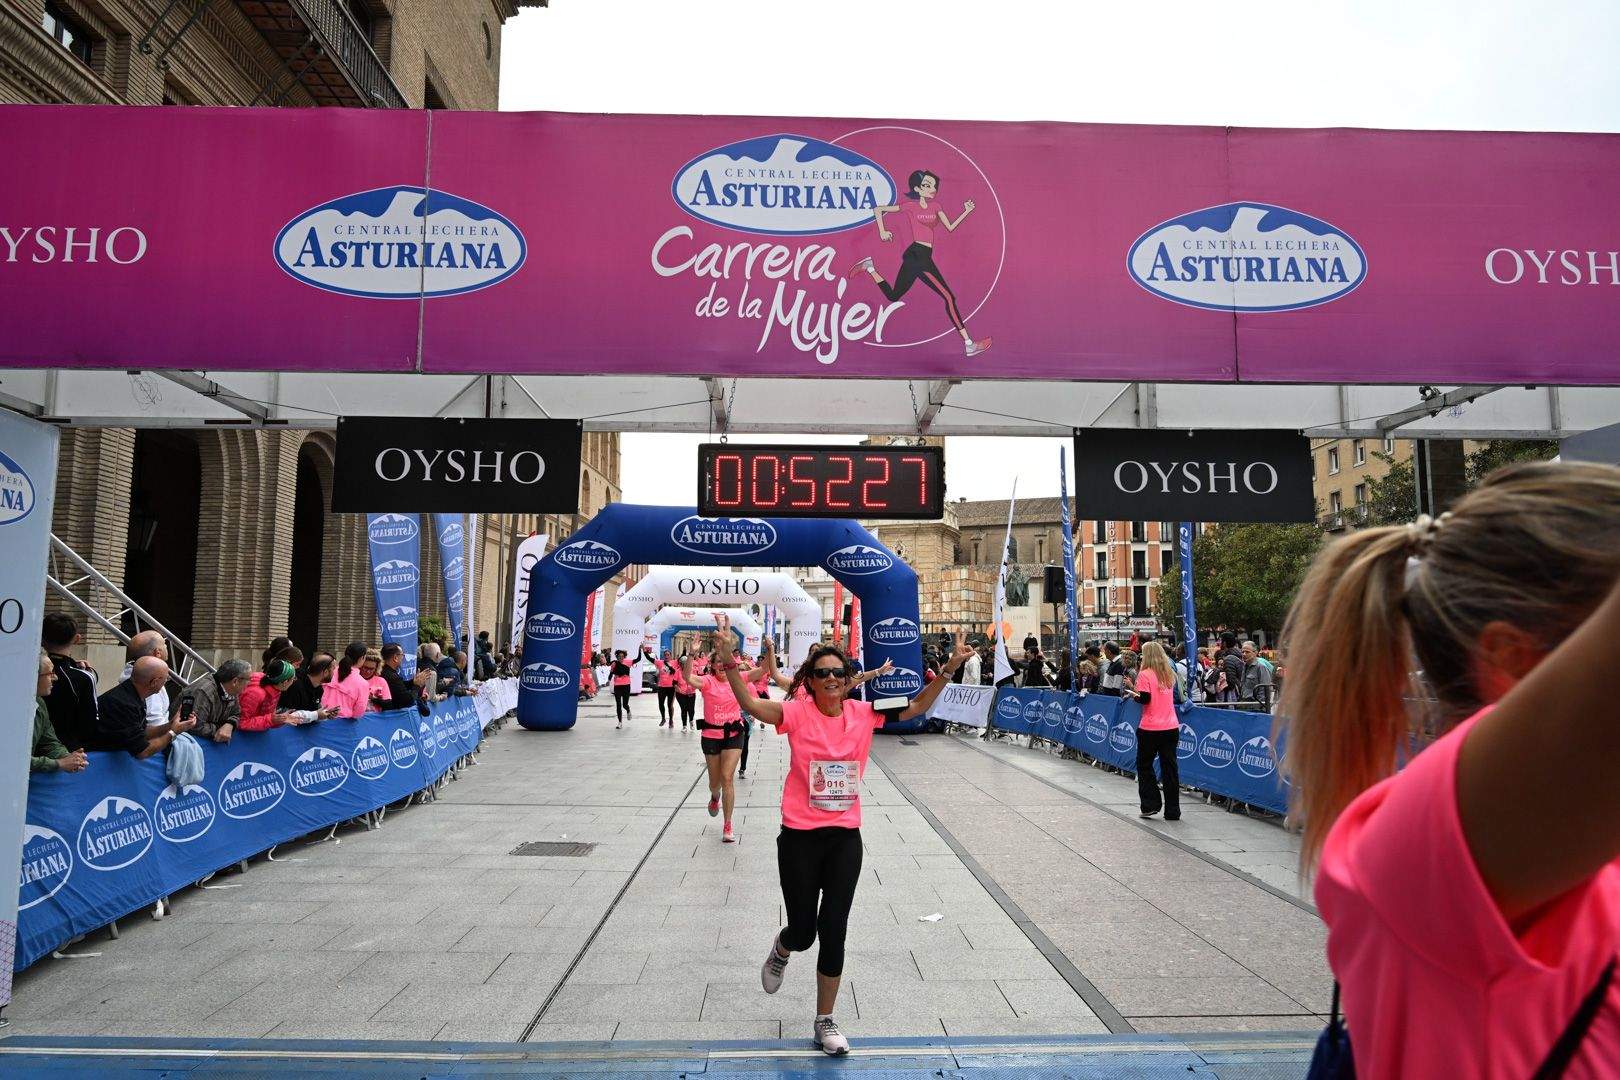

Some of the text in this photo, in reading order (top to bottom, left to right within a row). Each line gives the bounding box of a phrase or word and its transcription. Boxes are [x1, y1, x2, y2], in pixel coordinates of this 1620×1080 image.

[724, 167, 872, 181] CENTRAL LECHERA
[689, 169, 878, 210] ASTURIANA
[334, 224, 499, 237] CENTRAL LECHERA
[293, 226, 507, 270] ASTURIANA
[651, 225, 838, 282] Carrera
[1183, 239, 1340, 251] CENTRAL LECHERA
[1147, 241, 1350, 283] ASTURIANA
[695, 277, 906, 365] de la Mujer
[375, 447, 546, 485] OYSHO
[1113, 460, 1278, 495] OYSHO
[679, 524, 769, 545] ASTURIANA
[558, 550, 616, 565] ASTURIANA
[832, 556, 889, 568] ASTURIANA
[678, 578, 760, 596] OYSHO
[527, 621, 572, 636] ASTURIANA
[522, 671, 566, 686] ASTURIANA
[943, 687, 981, 707] OYSHO
[1201, 741, 1233, 761] ASTURIANA
[1240, 748, 1273, 770] ASTURIANA
[357, 753, 388, 772] ASTURIANA
[295, 764, 346, 789] ASTURIANA
[827, 780, 845, 788] 016
[224, 780, 283, 811] ASTURIANA
[160, 802, 213, 833] ASTURIANA
[93, 821, 119, 835] CENTRAL
[86, 821, 152, 861] ASTURIANA
